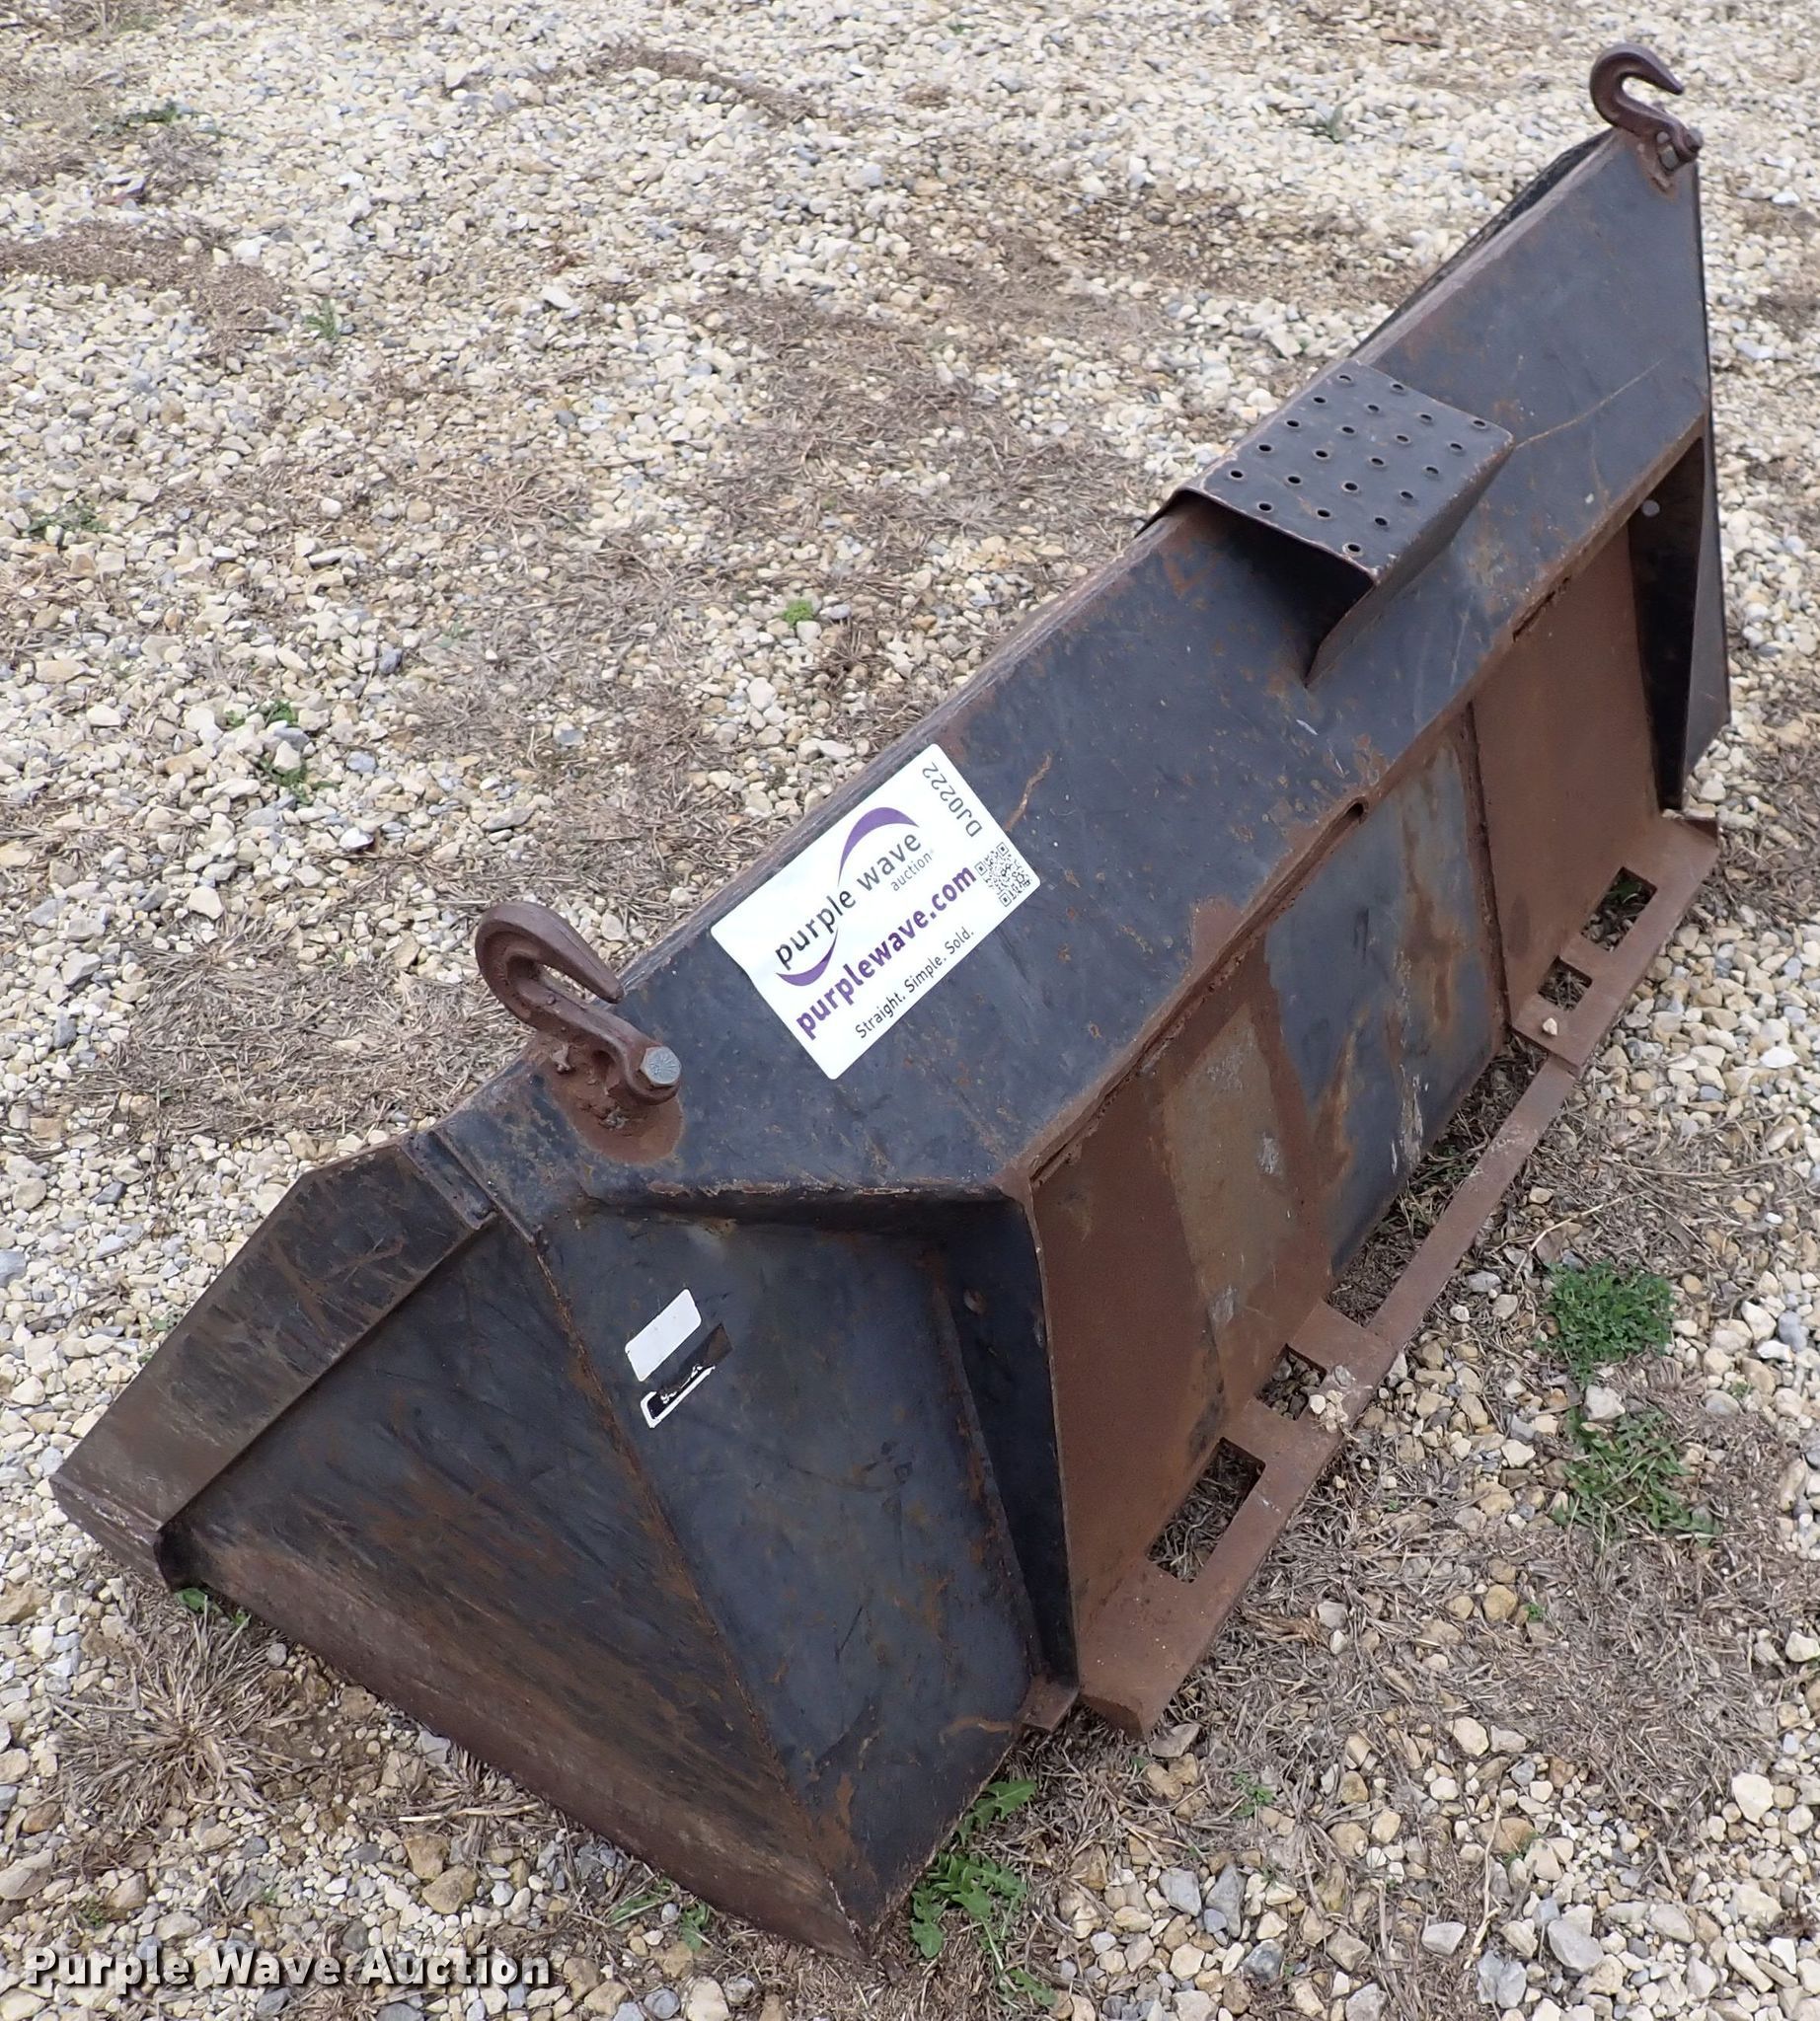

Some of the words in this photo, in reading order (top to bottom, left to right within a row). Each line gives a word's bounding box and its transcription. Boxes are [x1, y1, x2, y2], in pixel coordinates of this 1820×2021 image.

[922, 761, 982, 838] DJ0222
[775, 888, 856, 970] purple
[857, 833, 921, 892] wave
[890, 853, 932, 892] auction
[796, 866, 976, 1040] purplewave.com
[855, 995, 906, 1038] Straight.
[904, 957, 947, 993] Simple.
[944, 929, 974, 955] Sold.
